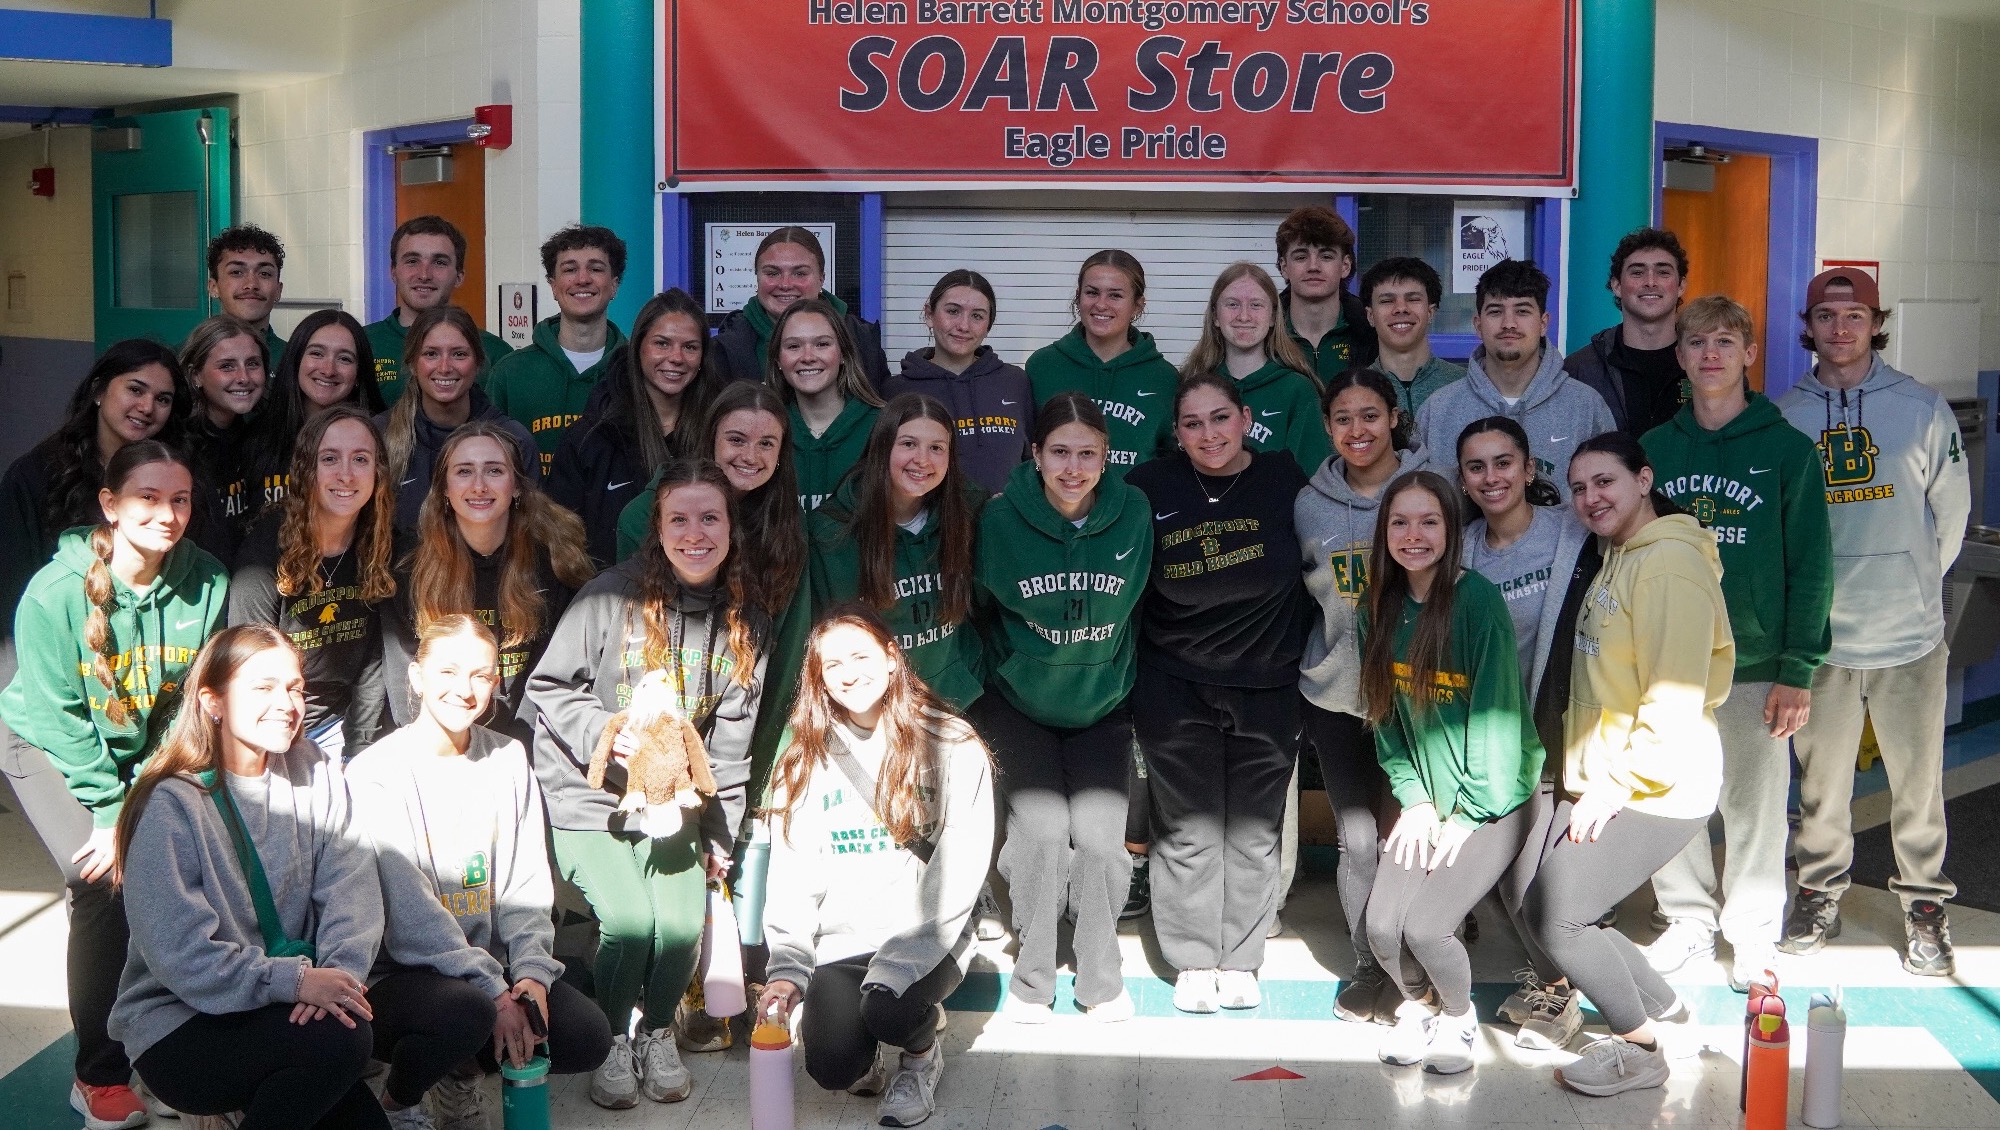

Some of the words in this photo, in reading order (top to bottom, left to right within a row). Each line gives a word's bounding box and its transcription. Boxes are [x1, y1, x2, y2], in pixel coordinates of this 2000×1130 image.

[808, 0, 907, 25] Helen
[916, 0, 1043, 25] Barrett
[1051, 0, 1280, 31] Montgomery
[1286, 0, 1429, 25] School's
[839, 35, 1099, 112] SOAR
[1127, 35, 1395, 113] Store
[1004, 125, 1110, 168] Eagle
[1121, 125, 1227, 159] Pride
[1462, 252, 1485, 260] EAGLE
[508, 315, 529, 328] SOAR
[511, 330, 525, 340] Store
[1825, 484, 1895, 505] ACROSSE
[1161, 519, 1260, 551] BROCKPORT
[1163, 560, 1204, 579] FIELD
[1206, 543, 1265, 572] HOCKEY
[831, 829, 866, 842] ROSS
